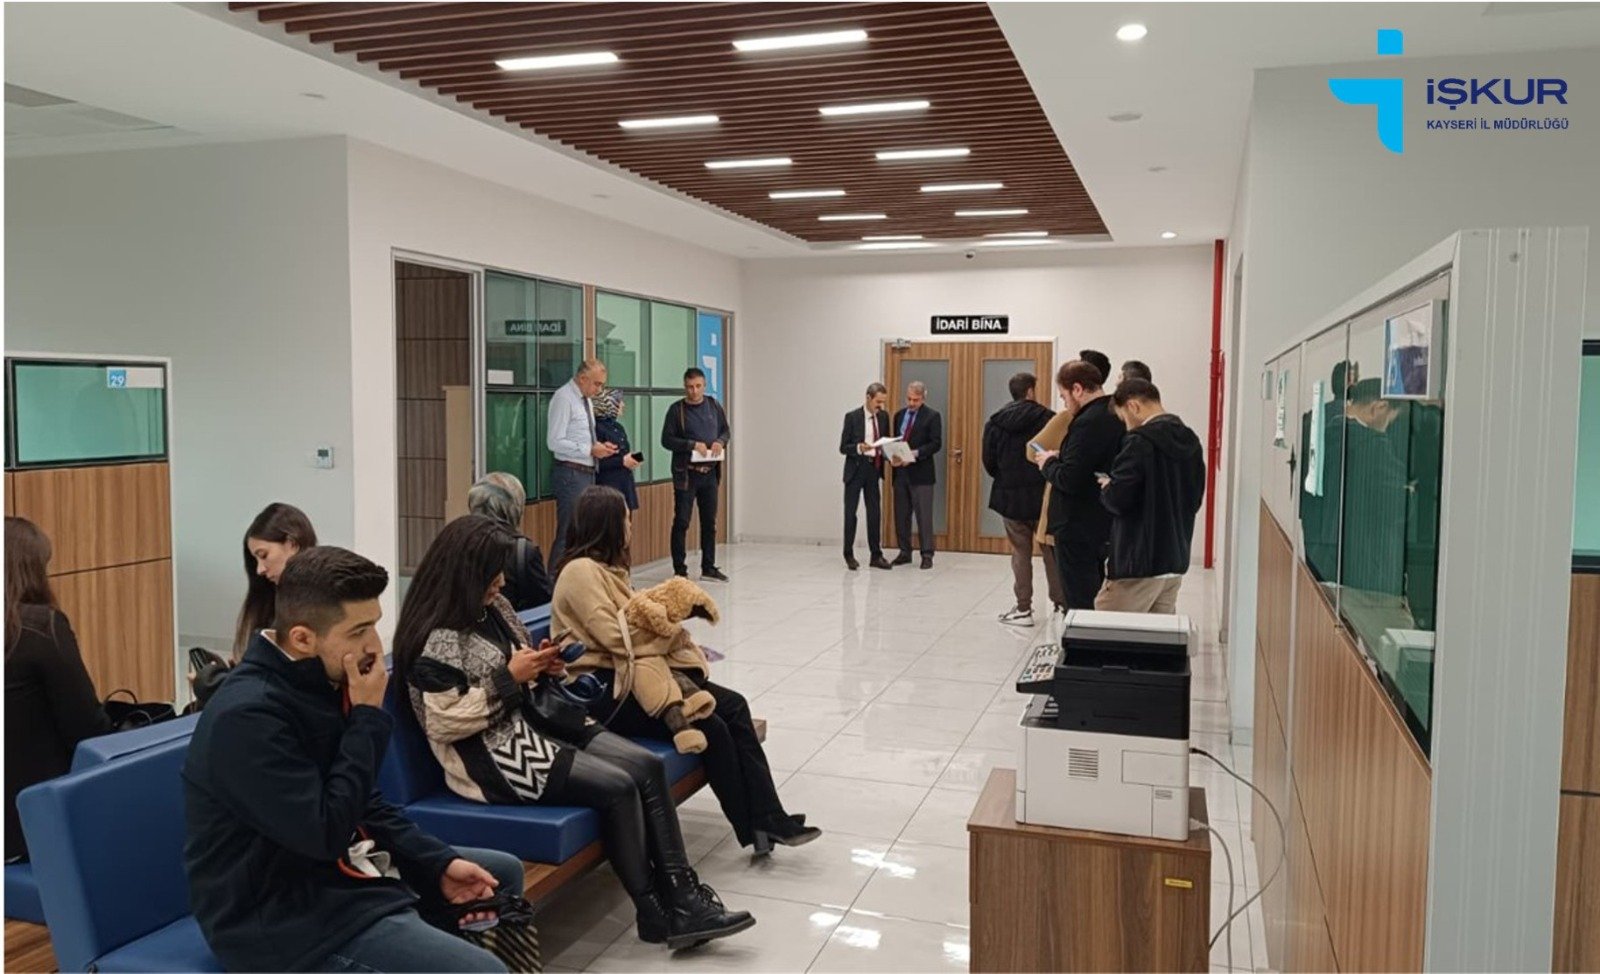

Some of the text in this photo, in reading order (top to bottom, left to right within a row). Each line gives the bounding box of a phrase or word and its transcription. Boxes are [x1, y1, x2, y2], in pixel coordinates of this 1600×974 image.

[936, 317, 1002, 330] İDARİ BİNA
[110, 375, 125, 387] 29
